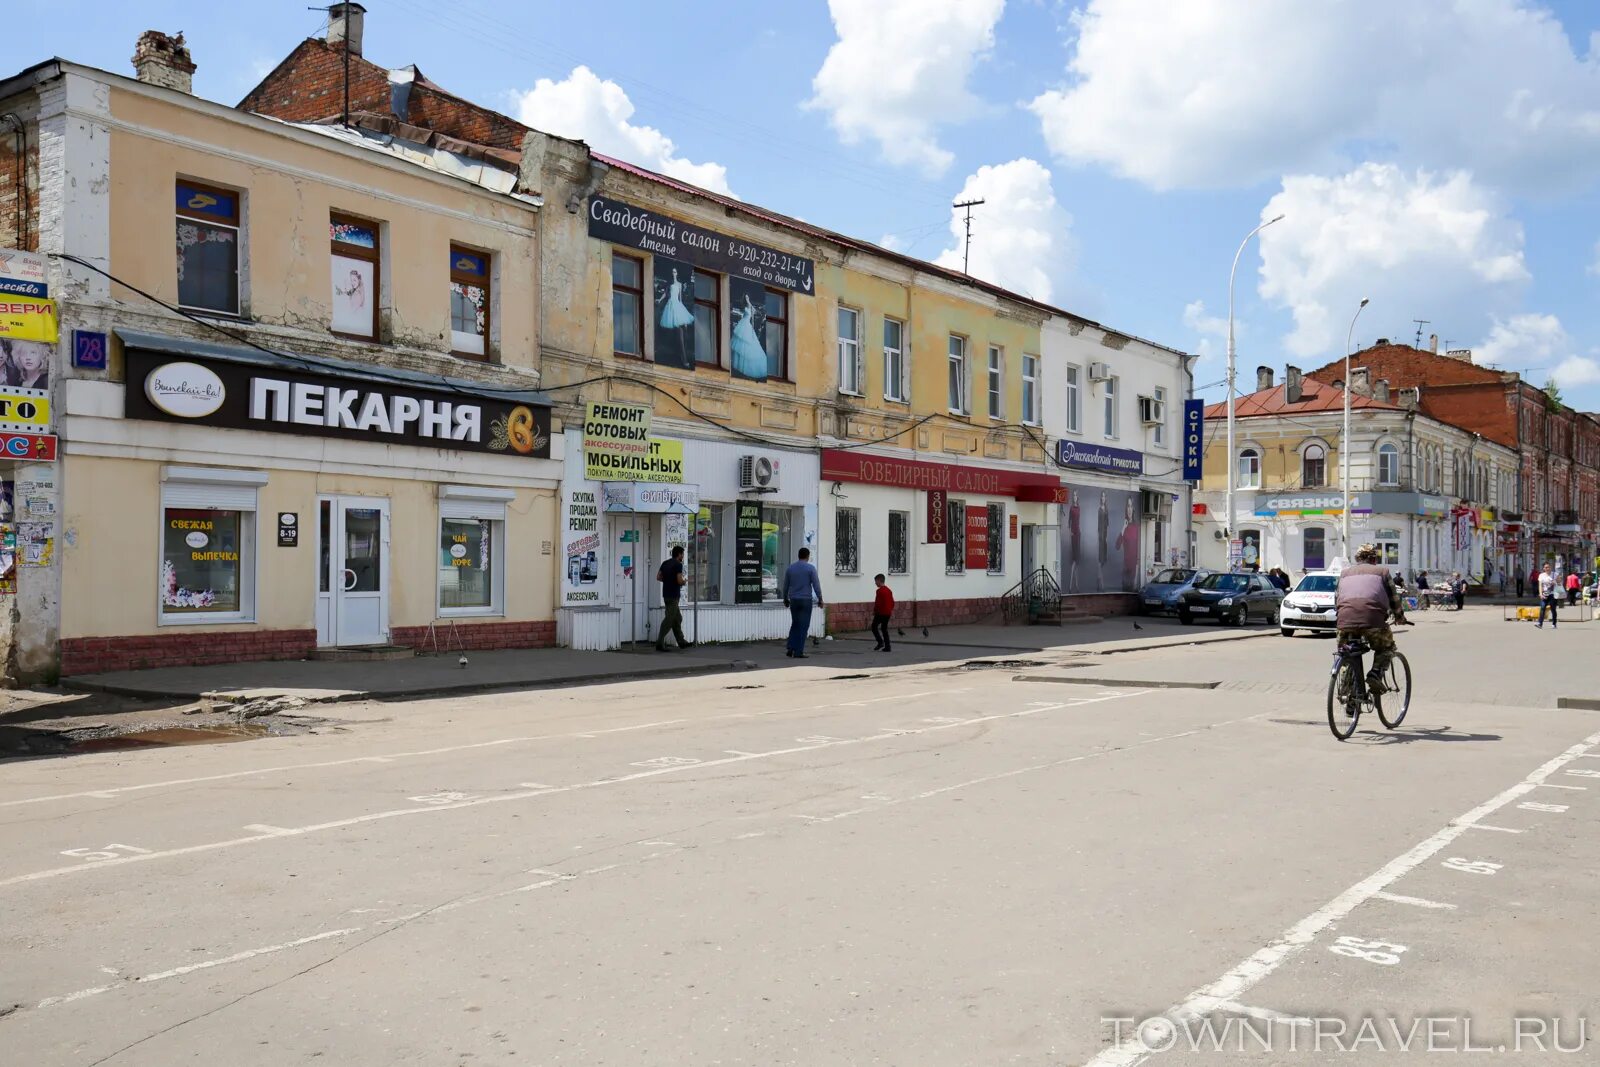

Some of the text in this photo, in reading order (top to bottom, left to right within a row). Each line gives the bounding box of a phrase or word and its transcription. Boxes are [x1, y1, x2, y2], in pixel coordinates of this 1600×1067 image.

[591, 200, 806, 275] Свадебный салон 8-920-232-21-41
[639, 235, 677, 255] Ателье
[743, 266, 797, 288] вход со двора
[80, 337, 102, 362] 28
[249, 377, 481, 441] ПЕКАРНЯ
[592, 405, 645, 422] РЕМОНТ
[586, 422, 647, 441] СОТОВЫХ
[1188, 410, 1199, 467] СТОКИ
[584, 440, 647, 453] аксессуары
[587, 452, 682, 474] МОБИЛЬНЫХ
[587, 468, 614, 478] ПОКУПКА
[859, 461, 999, 493] ЮВЕЛИРНЫЙ САЛОН
[572, 492, 595, 503] СКУПКА
[1266, 495, 1359, 509] СВЯЗНОЙ
[569, 505, 598, 516] ПРОДАЖА
[933, 491, 942, 542] ЗОЛОТО
[171, 520, 213, 530] СВЕЖАЯ
[569, 518, 597, 531] РЕМОНТ
[192, 552, 239, 561] ВЫПЕЧКА
[567, 591, 599, 601] АКСЕССУАРЫ
